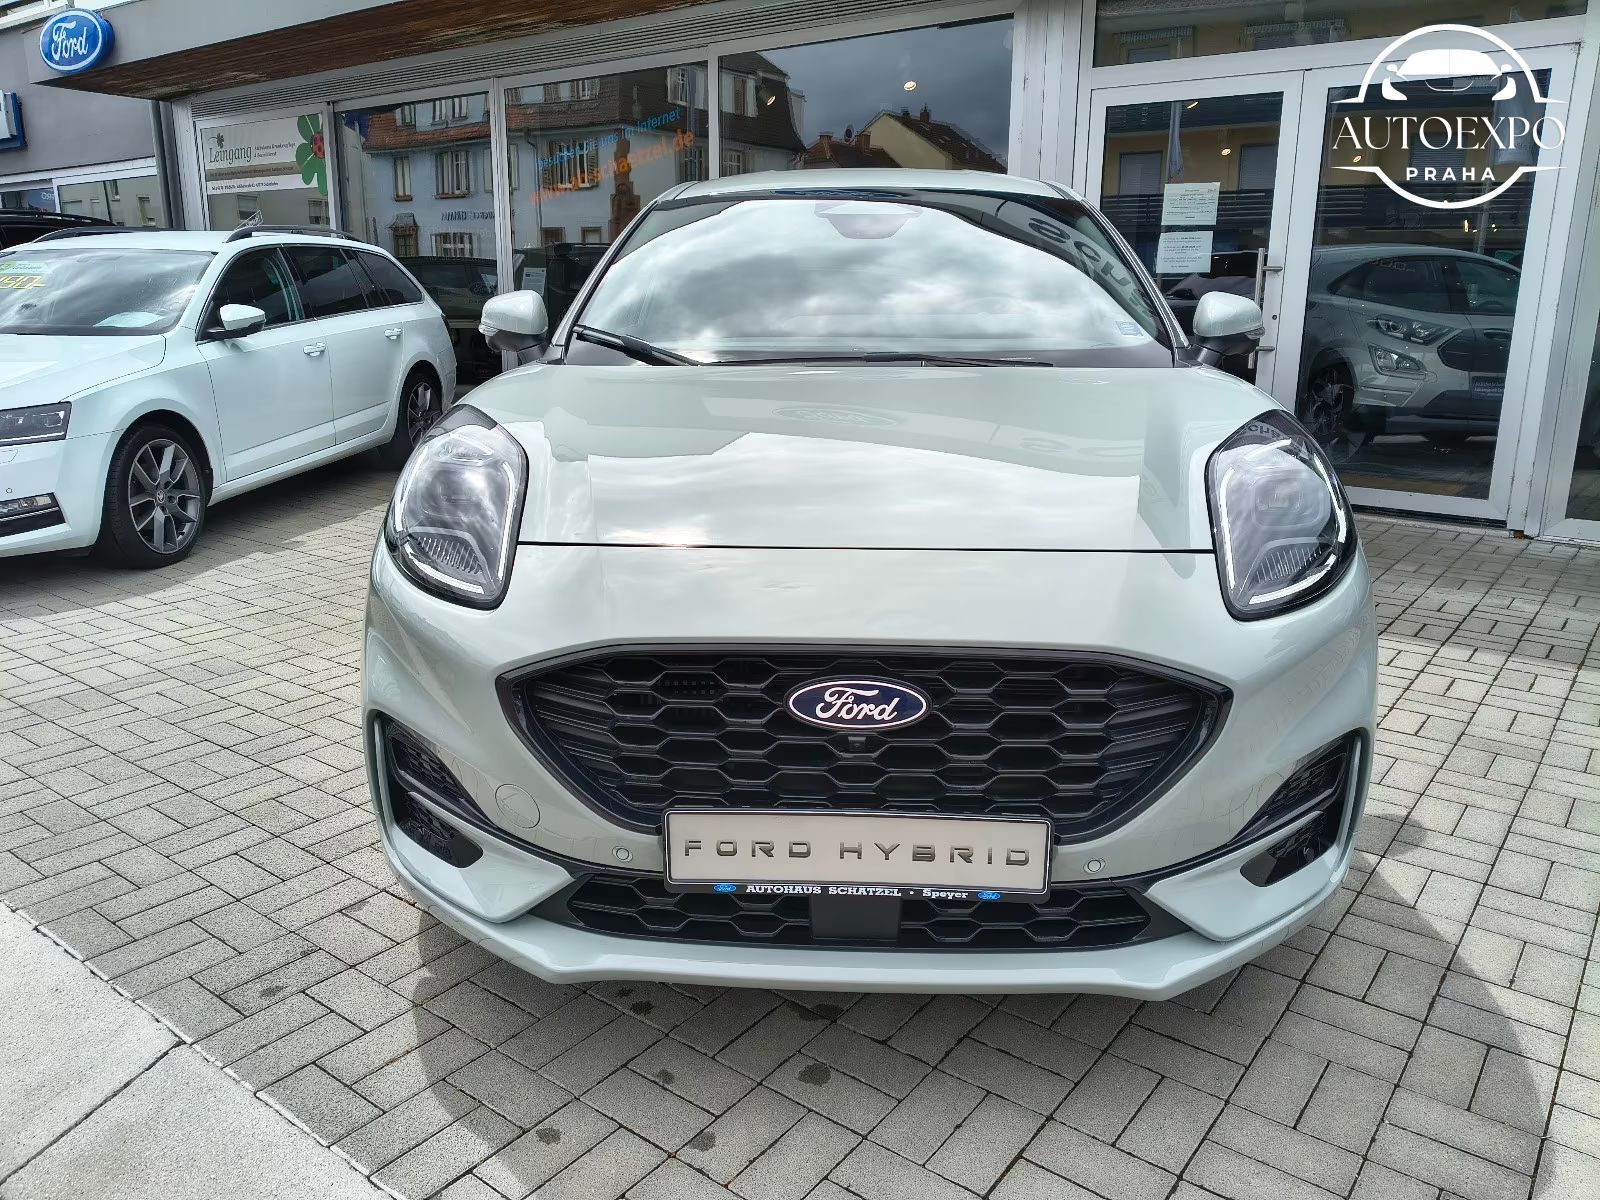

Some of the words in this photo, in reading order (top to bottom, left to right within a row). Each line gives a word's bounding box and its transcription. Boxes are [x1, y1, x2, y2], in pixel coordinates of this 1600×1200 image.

[51, 21, 88, 61] Ford
[815, 686, 901, 722] Ford
[684, 839, 812, 858] FORD
[840, 842, 1029, 866] HYBRID
[746, 885, 822, 894] AUTOHAUS
[922, 889, 969, 900] Speyer
